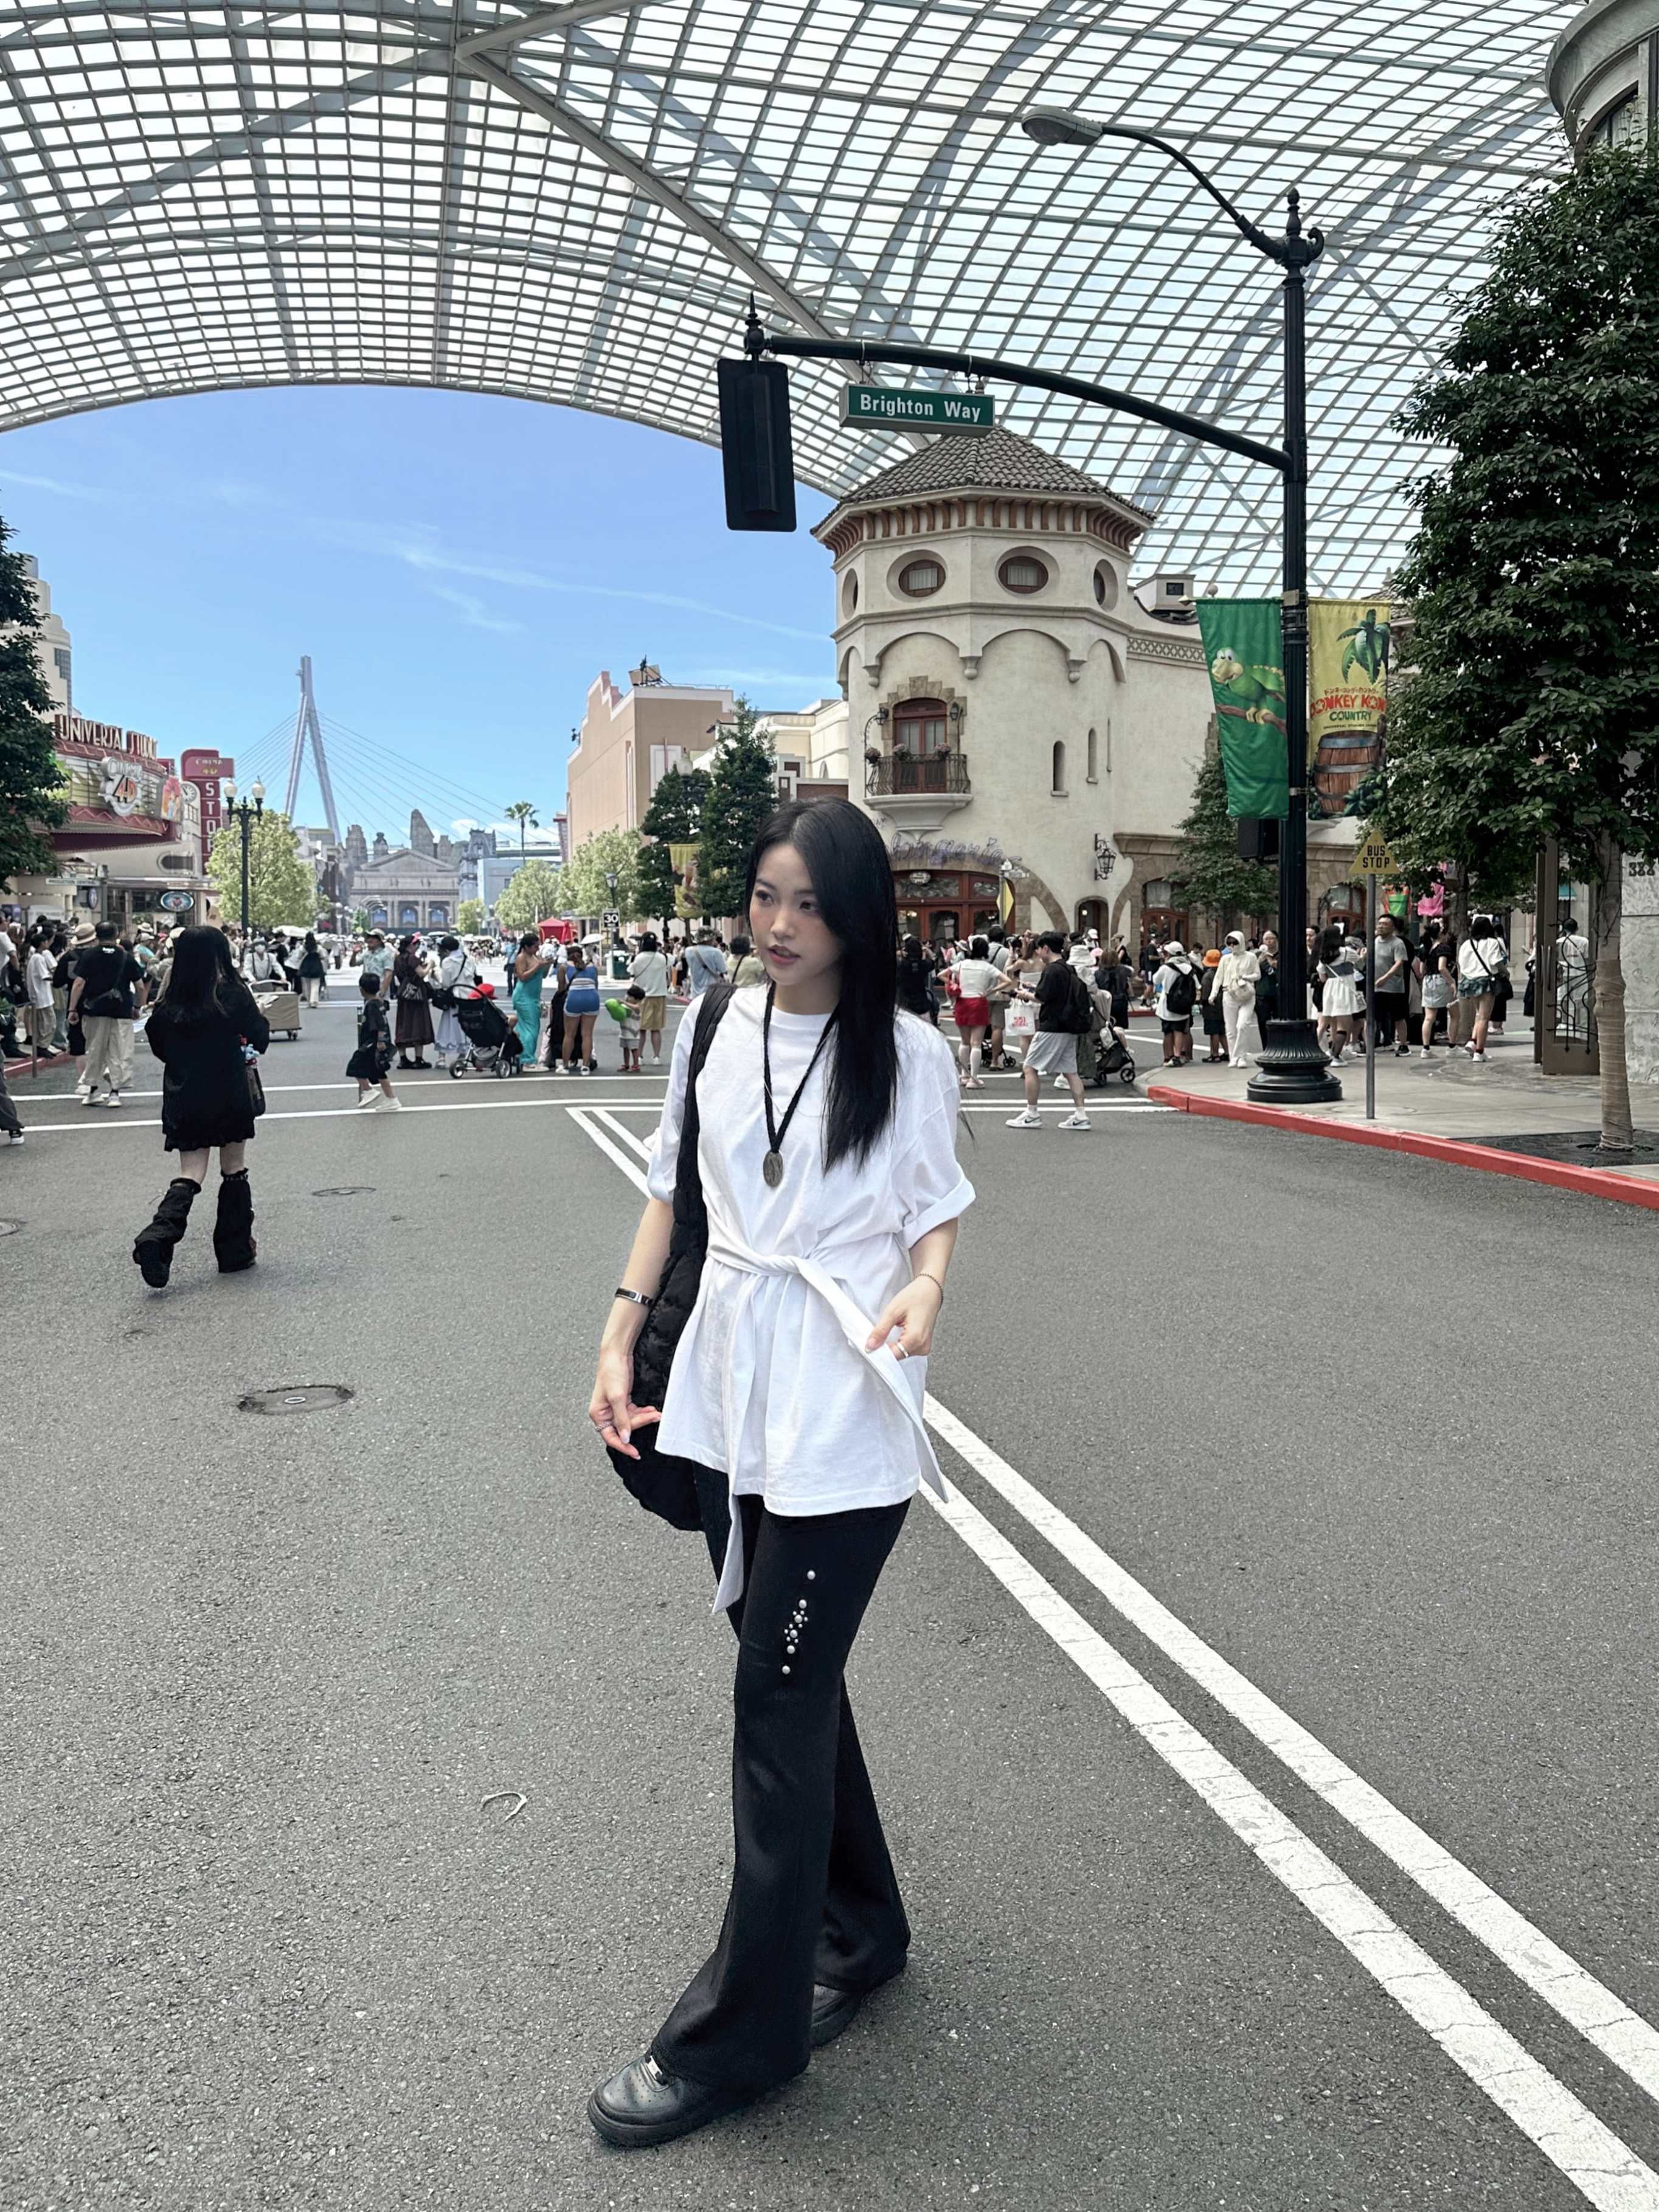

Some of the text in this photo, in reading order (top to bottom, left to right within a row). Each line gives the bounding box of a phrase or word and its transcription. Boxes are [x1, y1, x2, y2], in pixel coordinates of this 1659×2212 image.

[861, 394, 981, 423] Brighton Way
[1310, 695, 1386, 719] DONKEY KON
[1329, 710, 1372, 721] COUNTRY
[1367, 845, 1385, 856] BUS
[1363, 857, 1390, 869] STOP
[604, 914, 618, 923] 30
